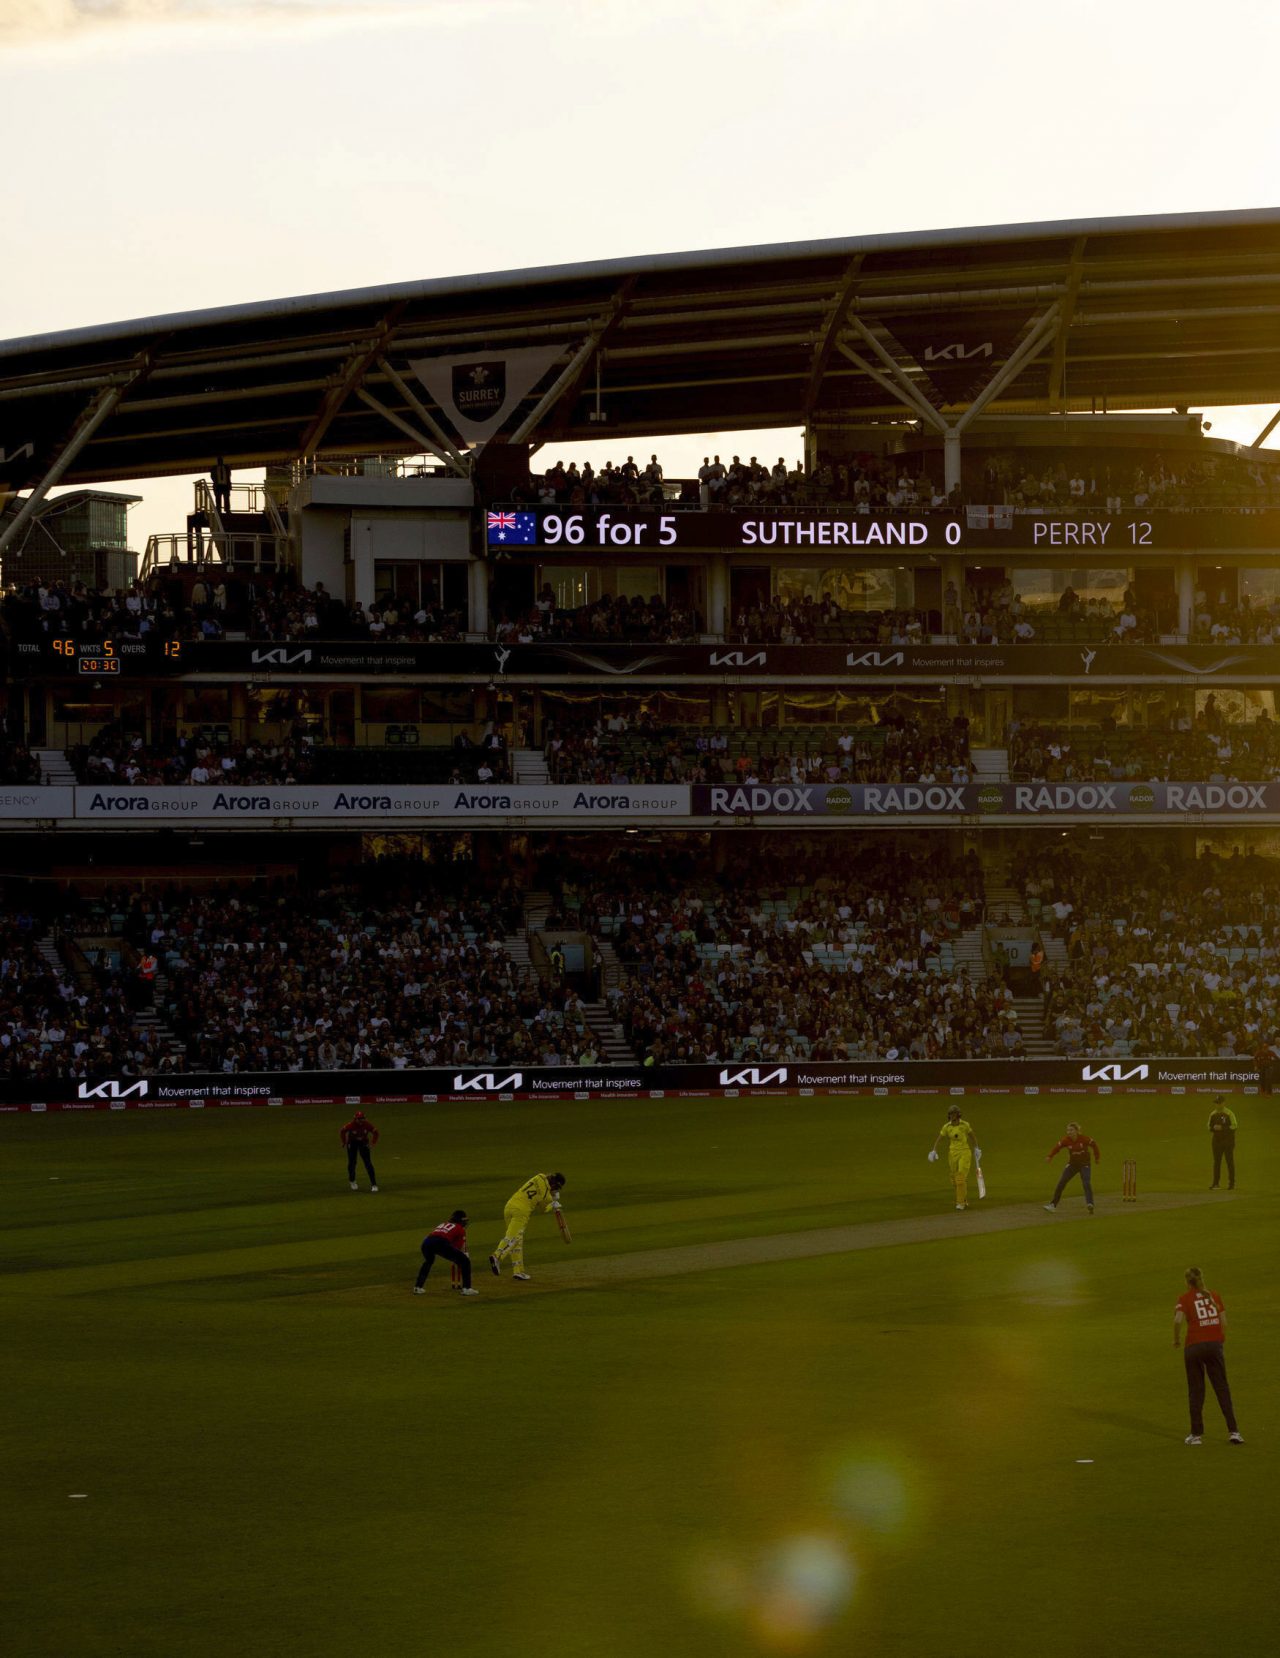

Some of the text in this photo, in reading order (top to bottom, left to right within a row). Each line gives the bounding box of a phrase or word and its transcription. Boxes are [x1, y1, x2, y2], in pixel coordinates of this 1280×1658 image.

[458, 388, 500, 401] SURREY
[543, 514, 678, 545] 96 for 5
[742, 521, 962, 546] SUTHERLAND 0
[1033, 522, 1153, 545] PERRY 12
[17, 640, 181, 657] TOTAL 96 WKTS 5 OVERS 12
[320, 655, 364, 666] Movement
[366, 655, 382, 666] that
[385, 655, 416, 667] inspires
[912, 656, 955, 667] Movement
[957, 656, 972, 667] that
[974, 656, 1005, 668] inspires
[90, 793, 198, 811] Arora GROUP
[212, 793, 319, 811] Arora GROUP
[334, 793, 440, 810] Arora GROUP
[454, 792, 559, 809] Arora GROUP
[573, 792, 678, 809] Arora GROUP
[711, 788, 814, 814] RADOX
[826, 796, 852, 804] RADOX
[864, 787, 966, 813] RADOX
[977, 795, 1003, 804] RADOX
[1015, 787, 1117, 812] RADOX
[1166, 786, 1267, 811] RADOX
[532, 1079, 582, 1090] Movement
[584, 1078, 603, 1089] that
[605, 1077, 641, 1090] inspires
[797, 1074, 847, 1085] Movement
[849, 1073, 868, 1084] that
[870, 1073, 905, 1085] inspires
[1158, 1071, 1207, 1081] Movement
[1209, 1071, 1227, 1080] that
[158, 1086, 210, 1098] Movement
[212, 1086, 231, 1097] that
[233, 1085, 271, 1098] inspires
